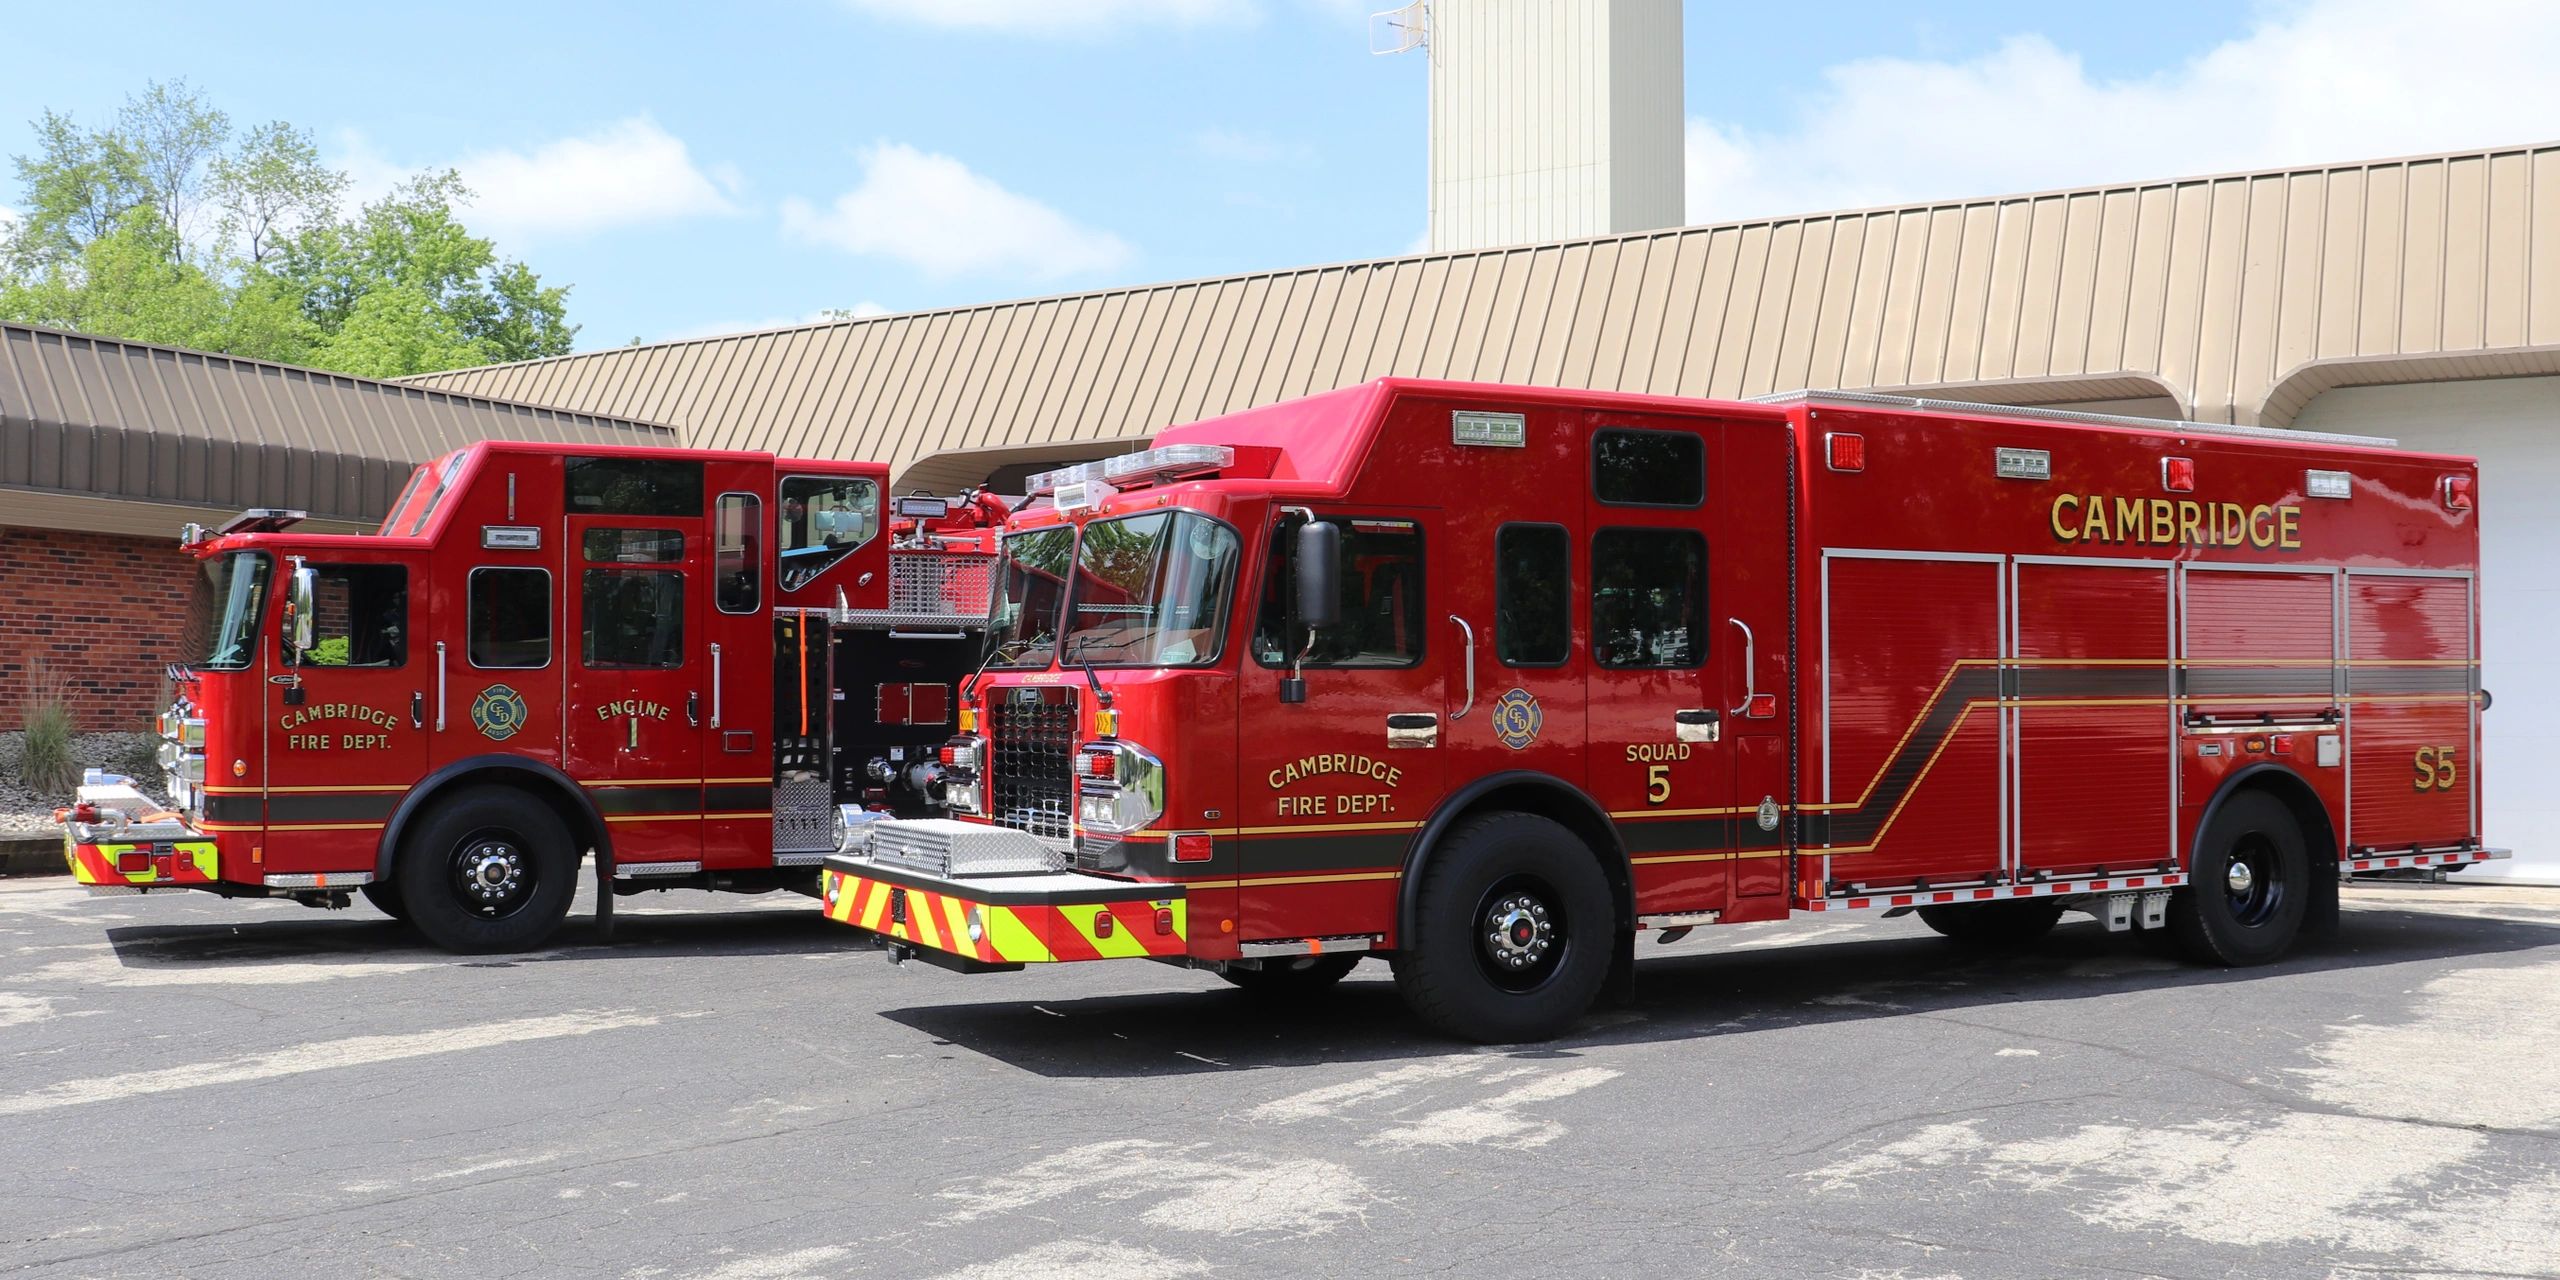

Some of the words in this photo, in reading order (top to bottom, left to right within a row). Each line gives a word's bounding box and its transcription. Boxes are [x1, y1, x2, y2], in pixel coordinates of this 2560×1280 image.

[2052, 493, 2301, 549] CAMBRIDGE
[280, 703, 398, 730] CAMBRIDGE
[490, 702, 510, 722] CFD
[597, 699, 670, 720] ENGINE
[1509, 707, 1526, 730] CFD
[289, 734, 330, 749] FIRE
[343, 734, 392, 749] DEPT.
[630, 717, 638, 747] 1
[1626, 743, 1691, 762] SQUAD
[1268, 753, 1402, 789] CAMBRIDGE
[2413, 745, 2458, 791] S5
[1648, 765, 1671, 803] 5
[1278, 796, 1328, 816] FIRE
[1337, 794, 1396, 814] DEPT.
